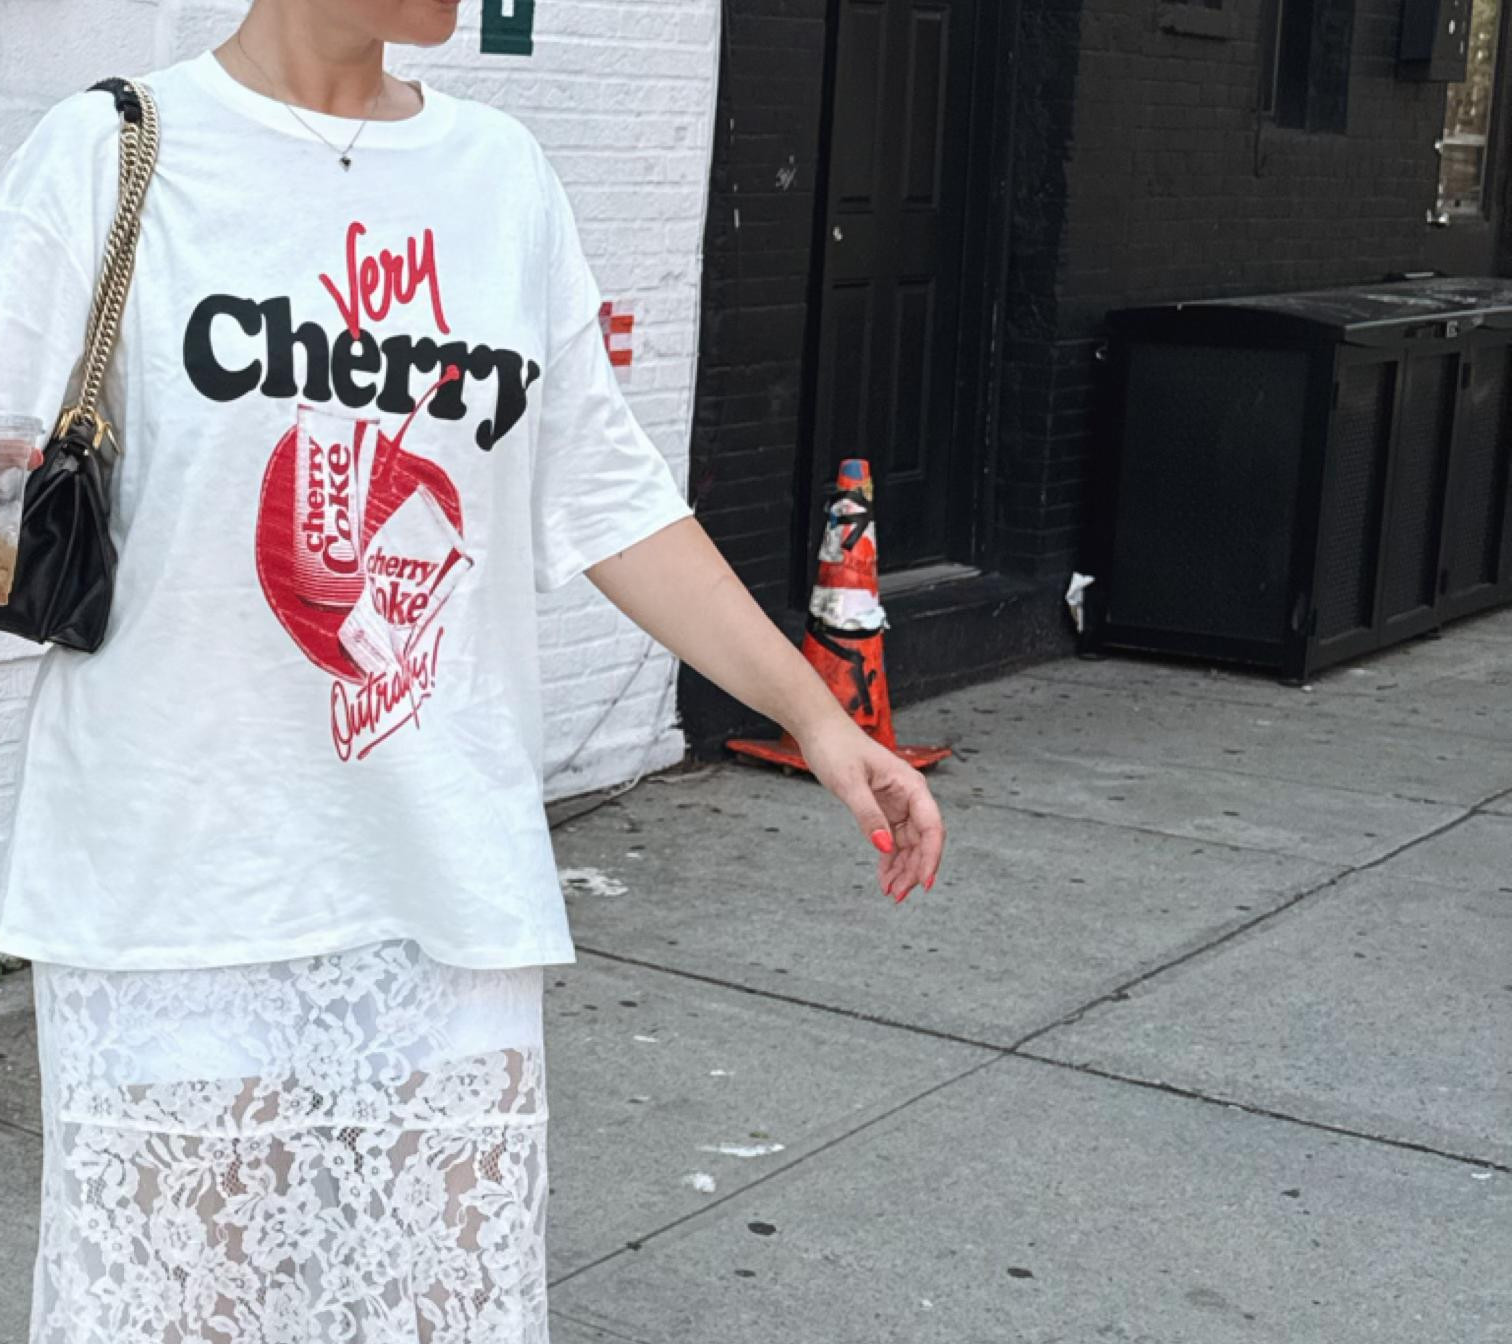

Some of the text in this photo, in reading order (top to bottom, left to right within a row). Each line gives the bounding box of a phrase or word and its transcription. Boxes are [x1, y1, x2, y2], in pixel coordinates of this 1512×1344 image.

[319, 221, 450, 341] Very
[183, 293, 541, 451] Cherry
[303, 435, 325, 553] cherry
[322, 443, 359, 575] Coke
